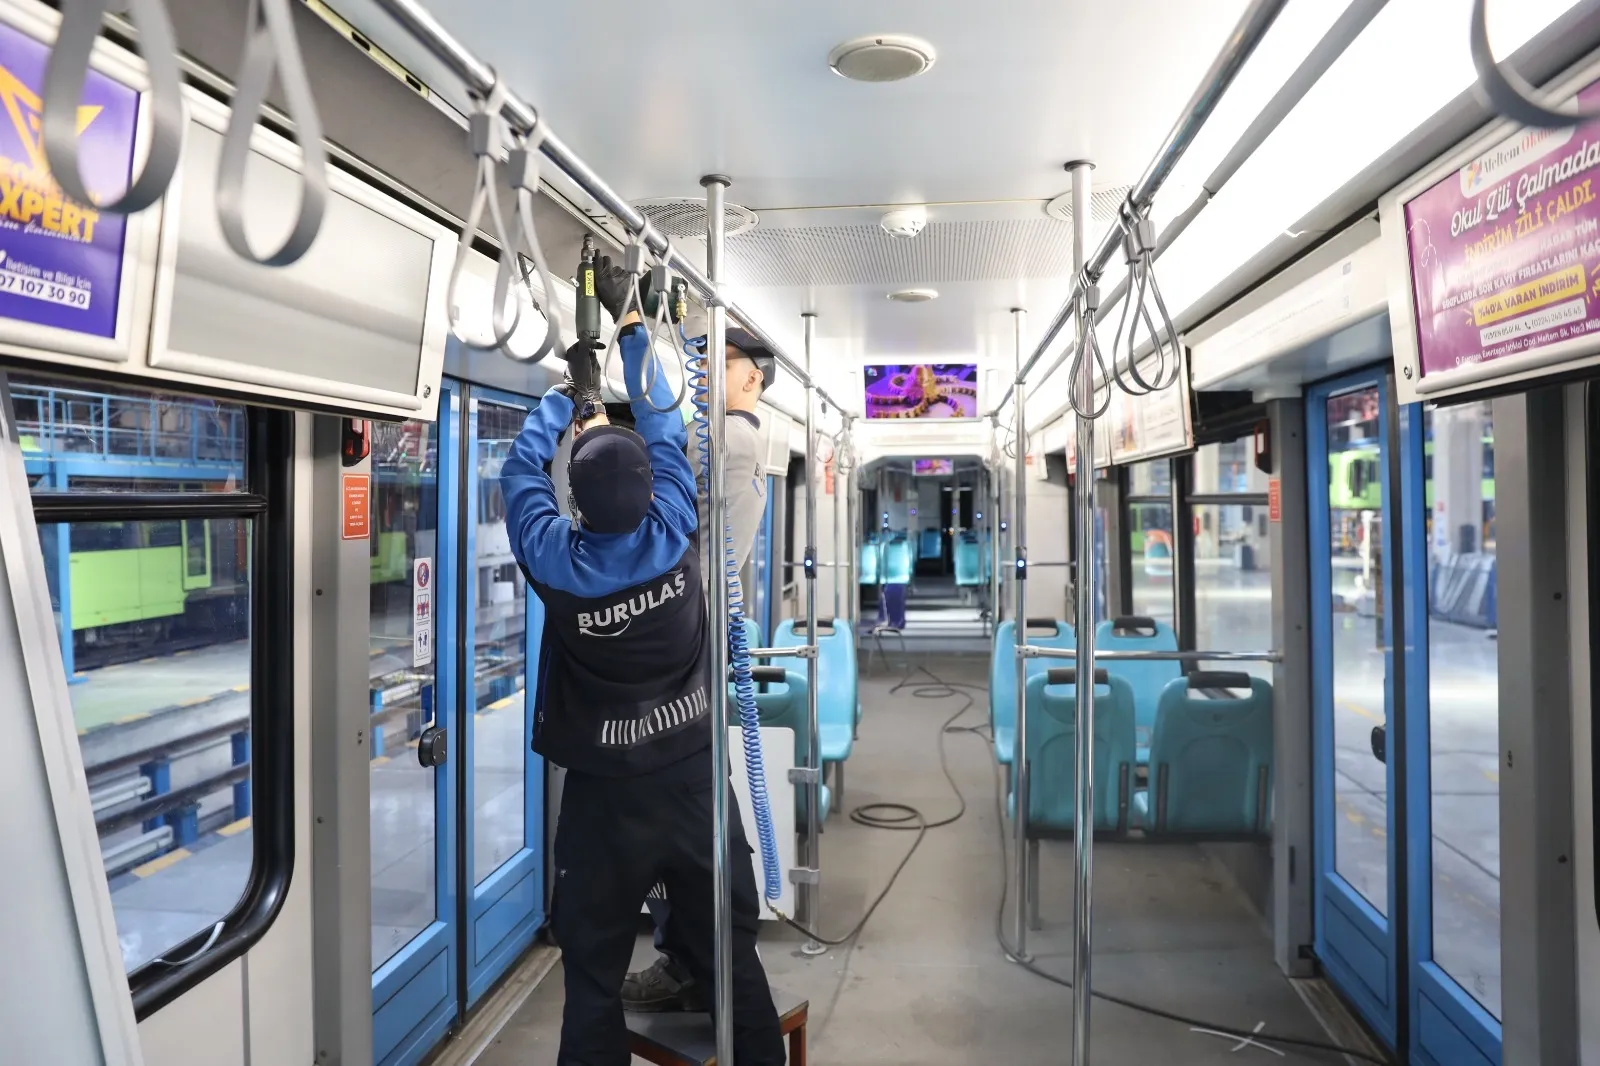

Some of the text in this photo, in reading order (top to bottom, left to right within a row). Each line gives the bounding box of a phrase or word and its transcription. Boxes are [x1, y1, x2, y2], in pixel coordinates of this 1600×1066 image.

[1451, 199, 1482, 237] Okul
[1486, 181, 1513, 221] Zili
[1464, 179, 1596, 262] İNDİRİM ZİLİ ÇALDI.
[42, 270, 54, 281] ve
[1518, 246, 1579, 281] FIRSATLARINI
[21, 279, 44, 295] 107
[48, 285, 65, 299] 30
[69, 291, 86, 305] 90
[1504, 288, 1537, 308] VARAN
[1539, 273, 1579, 297] İNDİRİM
[577, 573, 686, 629] BURULAŞ
